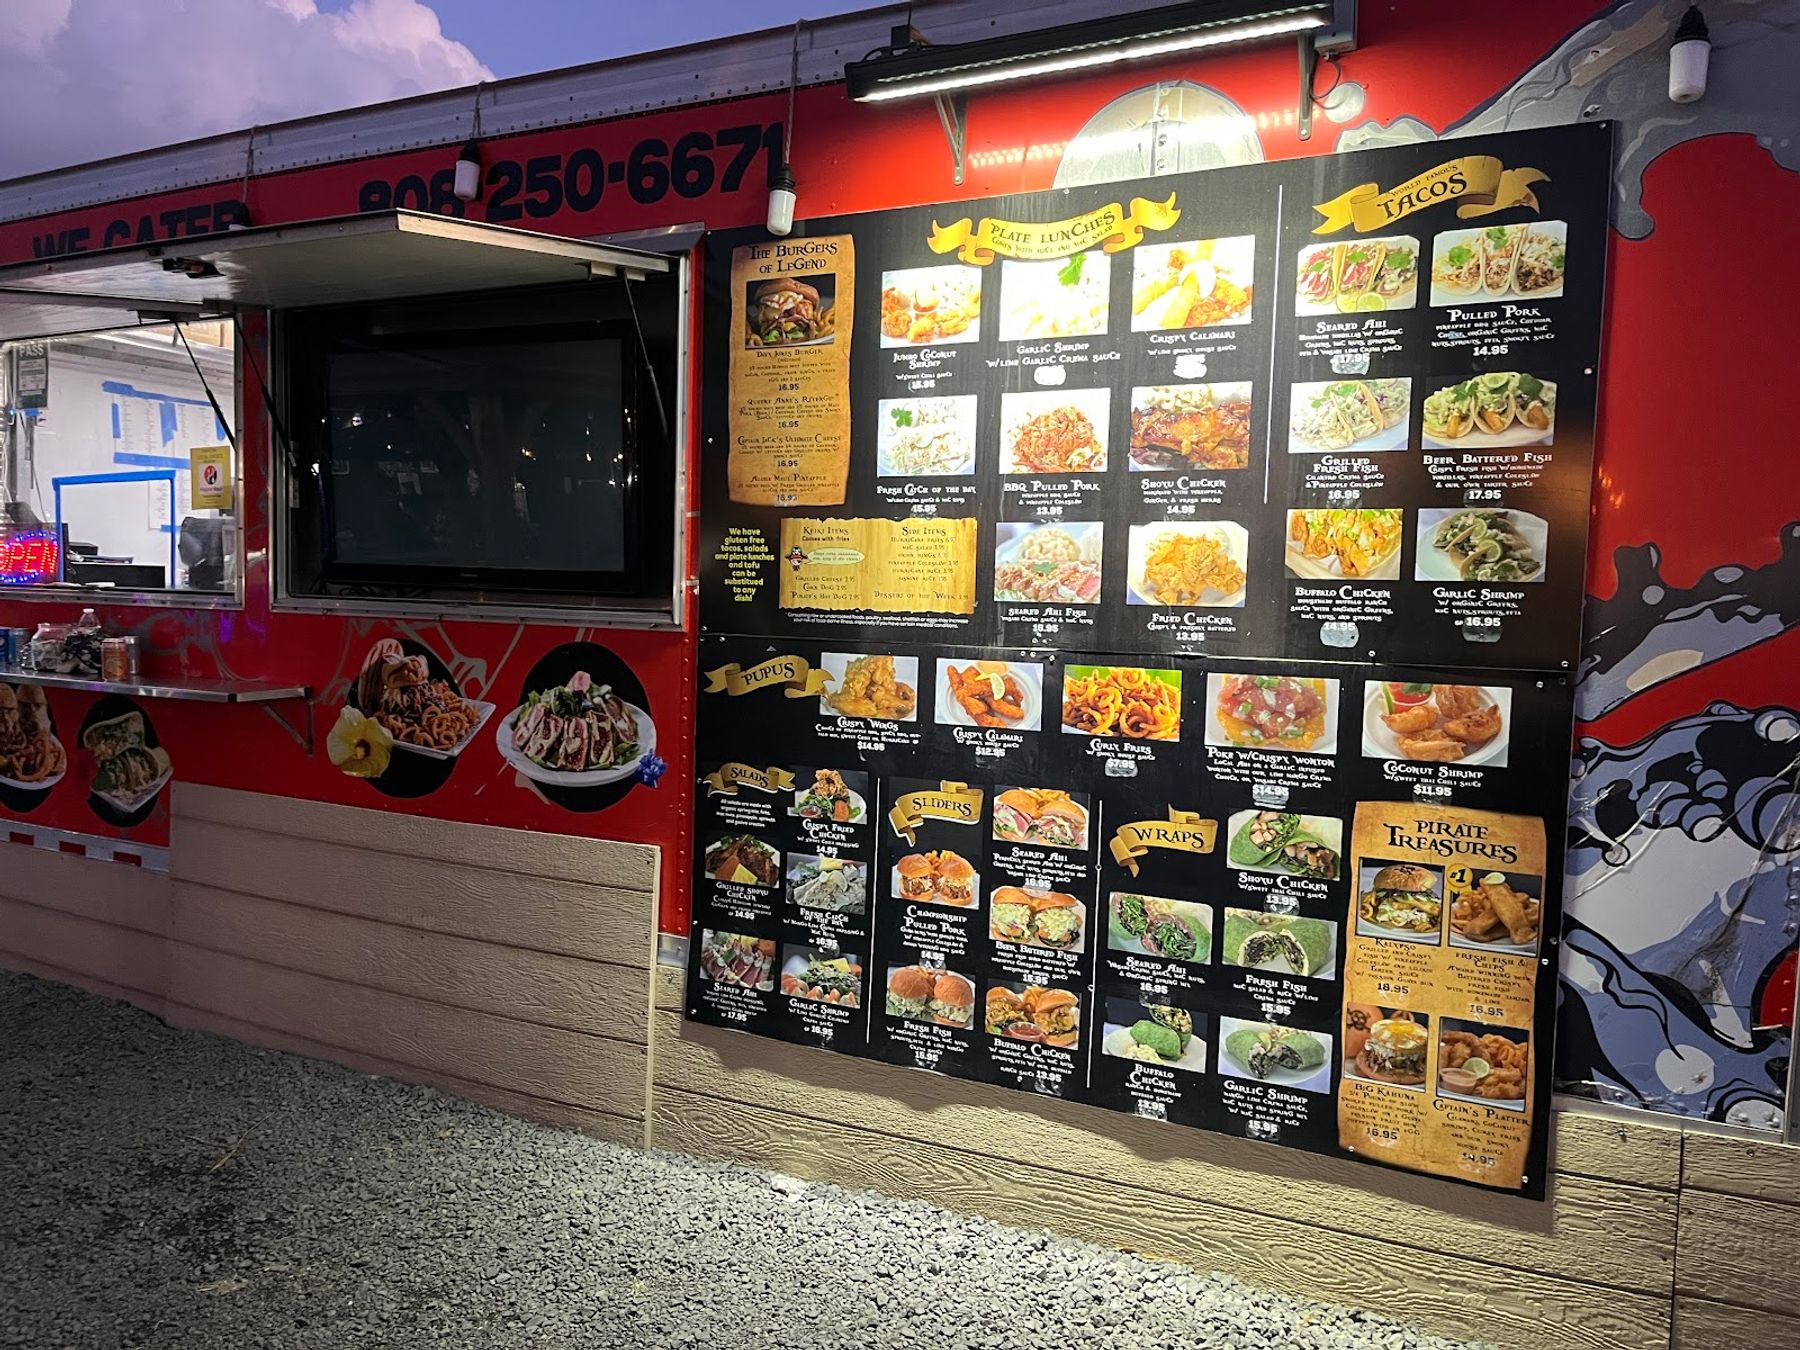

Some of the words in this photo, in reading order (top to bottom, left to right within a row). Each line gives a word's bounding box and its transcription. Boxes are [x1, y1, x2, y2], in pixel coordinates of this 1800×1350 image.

[1377, 172, 1468, 218] TACOS
[991, 223, 1031, 243] PLATE
[1041, 211, 1115, 243] LUNCHES
[748, 245, 770, 259] THE
[776, 242, 838, 257] BURGERS
[760, 264, 772, 274] OF
[778, 258, 826, 272] LEGEND
[1446, 309, 1497, 321] PULLED
[1501, 306, 1541, 318] PORK
[1017, 345, 1050, 354] GARLIC
[1473, 345, 1508, 356] 14.95
[1321, 455, 1370, 465] GRILLED
[1423, 455, 1456, 464] BEER
[1463, 454, 1518, 463] BATTERED
[1524, 453, 1552, 463] FISH
[1313, 464, 1348, 474] FRESH
[1353, 464, 1378, 473] FISH
[1031, 481, 1068, 491] PULLED
[1070, 479, 1100, 491] PORK
[1177, 476, 1226, 489] CHICKEN
[1469, 490, 1502, 499] 17.95
[1167, 506, 1196, 514] 14.95
[724, 536, 748, 545] gluten
[750, 536, 765, 544] free
[1295, 587, 1336, 598] BUFFALO
[1339, 585, 1391, 599] CHICKEN
[1432, 587, 1476, 599] GARLIC
[1480, 588, 1525, 600] SHRIMP
[1152, 613, 1180, 624] FRIED
[1184, 613, 1233, 626] CHICKEN
[1465, 617, 1501, 627] 16.95
[741, 662, 795, 686] PUPUS
[1124, 743, 1152, 754] FRIES
[1383, 760, 1434, 775] COCONUT
[1438, 766, 1483, 778] SHRIMP
[730, 767, 768, 788] SALADS
[1413, 784, 1452, 796] $11.95
[912, 798, 972, 816] SLIDERS
[1415, 820, 1489, 840] PIRATE
[1128, 826, 1205, 849] WRAPS
[1383, 823, 1518, 864] TREASURES
[1012, 847, 1045, 858] SEARED
[1276, 875, 1328, 893] CHICKEN
[903, 916, 937, 930] PULLED
[939, 922, 966, 936] PORK
[1245, 975, 1280, 989] FRESH
[1282, 981, 1308, 993] FISH
[1377, 982, 1409, 994] 18.95
[727, 1012, 747, 1021] 17.95
[1030, 1044, 1071, 1061] CHICKEN
[1036, 1070, 1062, 1082] 13.95
[1134, 1063, 1174, 1079] BUFFALO
[1129, 1072, 1176, 1090] CHICKEN
[1224, 1080, 1264, 1096] GARLIC
[1267, 1089, 1309, 1104] SHRIMP
[1484, 1108, 1531, 1126] PLATTER
